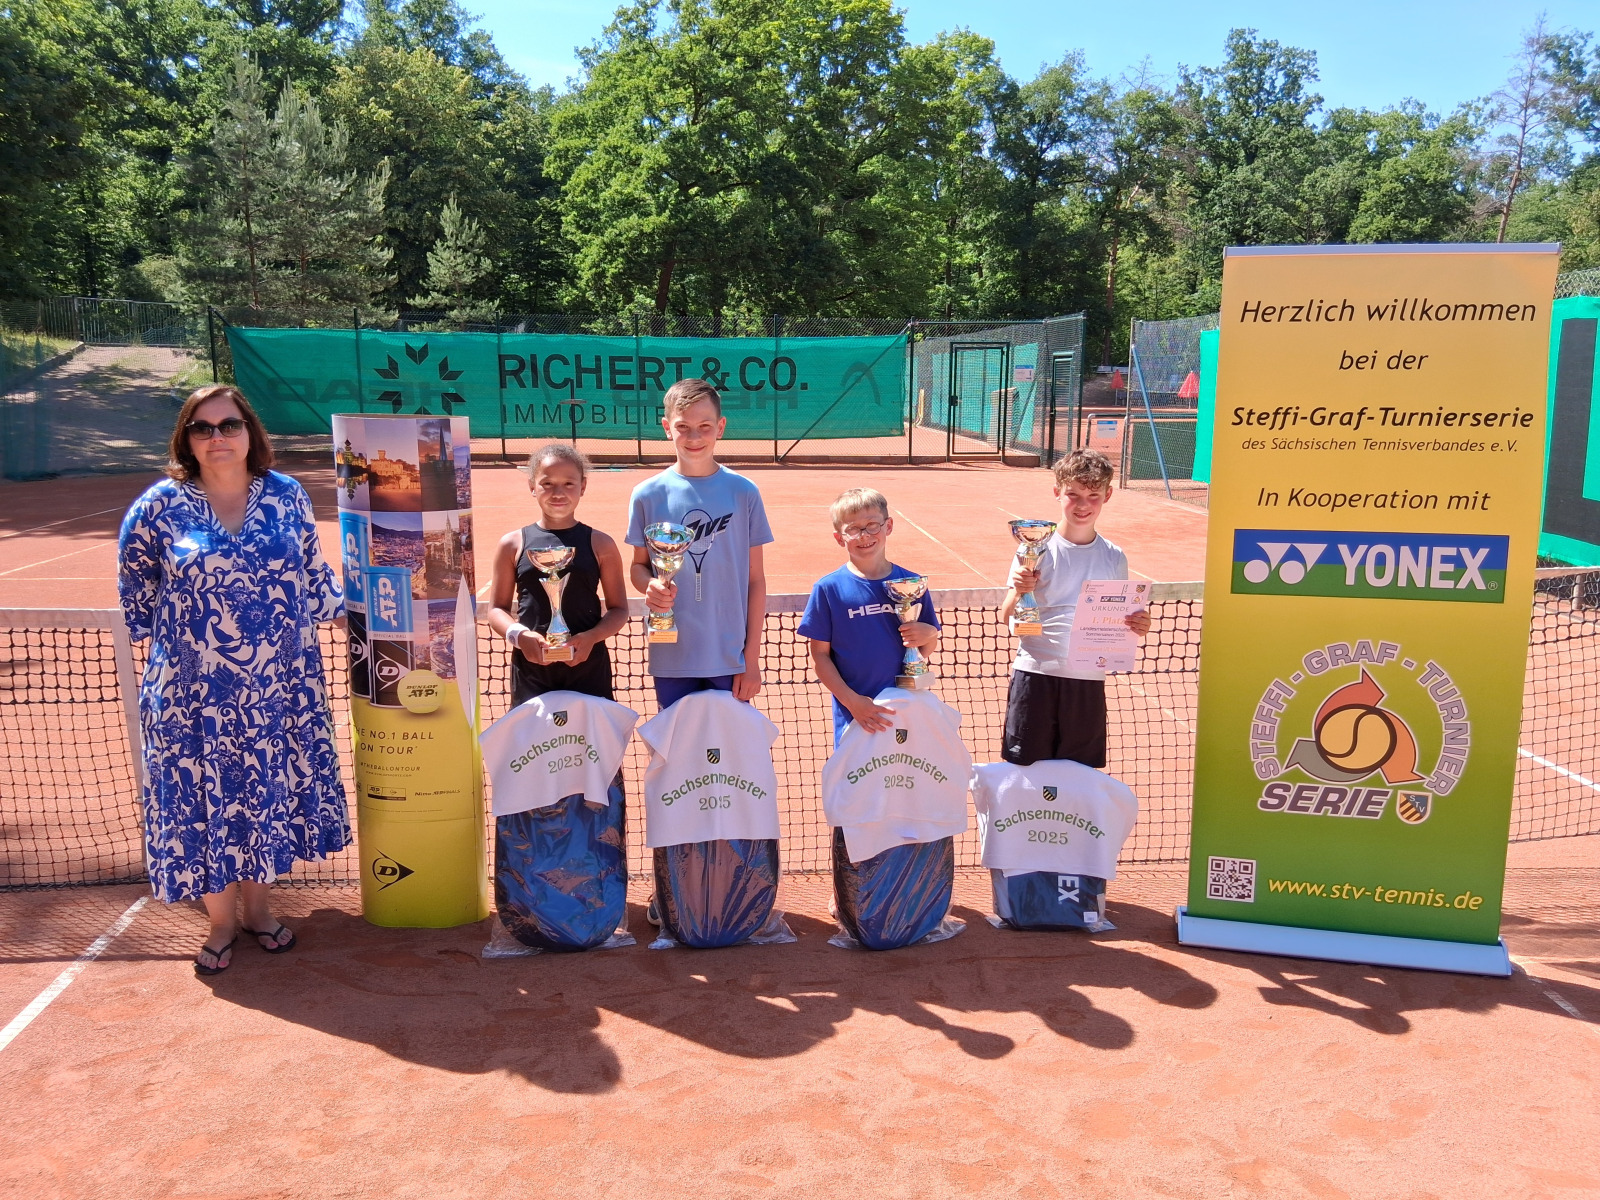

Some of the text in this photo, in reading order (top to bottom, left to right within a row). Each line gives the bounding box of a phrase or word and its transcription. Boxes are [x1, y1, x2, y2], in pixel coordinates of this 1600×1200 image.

[1239, 297, 1537, 324] Herzlich willkommen
[498, 353, 808, 392] RICHERT & CO.
[1339, 349, 1429, 371] bei der
[502, 403, 666, 425] IMMOBILIE
[1231, 406, 1535, 431] Steffi-Graf-Turnierserie
[1241, 437, 1266, 451] des
[1270, 437, 1356, 451] Sächsischen
[1362, 437, 1485, 453] Tennisverbandes
[1257, 487, 1491, 513] In Kooperation mit
[378, 577, 398, 629] ATP
[356, 726, 434, 740] HE NO.1 BALL
[360, 743, 374, 752] ON
[510, 734, 600, 773] Sachsenmeter
[548, 753, 583, 773] 2025
[846, 752, 948, 784] Sachsenmeister
[661, 773, 767, 806] Sachsenmeister
[884, 775, 915, 789] 2025
[1258, 782, 1393, 819] SERIE
[994, 808, 1106, 840] Sachsenmeister
[1027, 829, 1069, 845] 2025
[1268, 878, 1483, 911] www.stv-tennis.de
